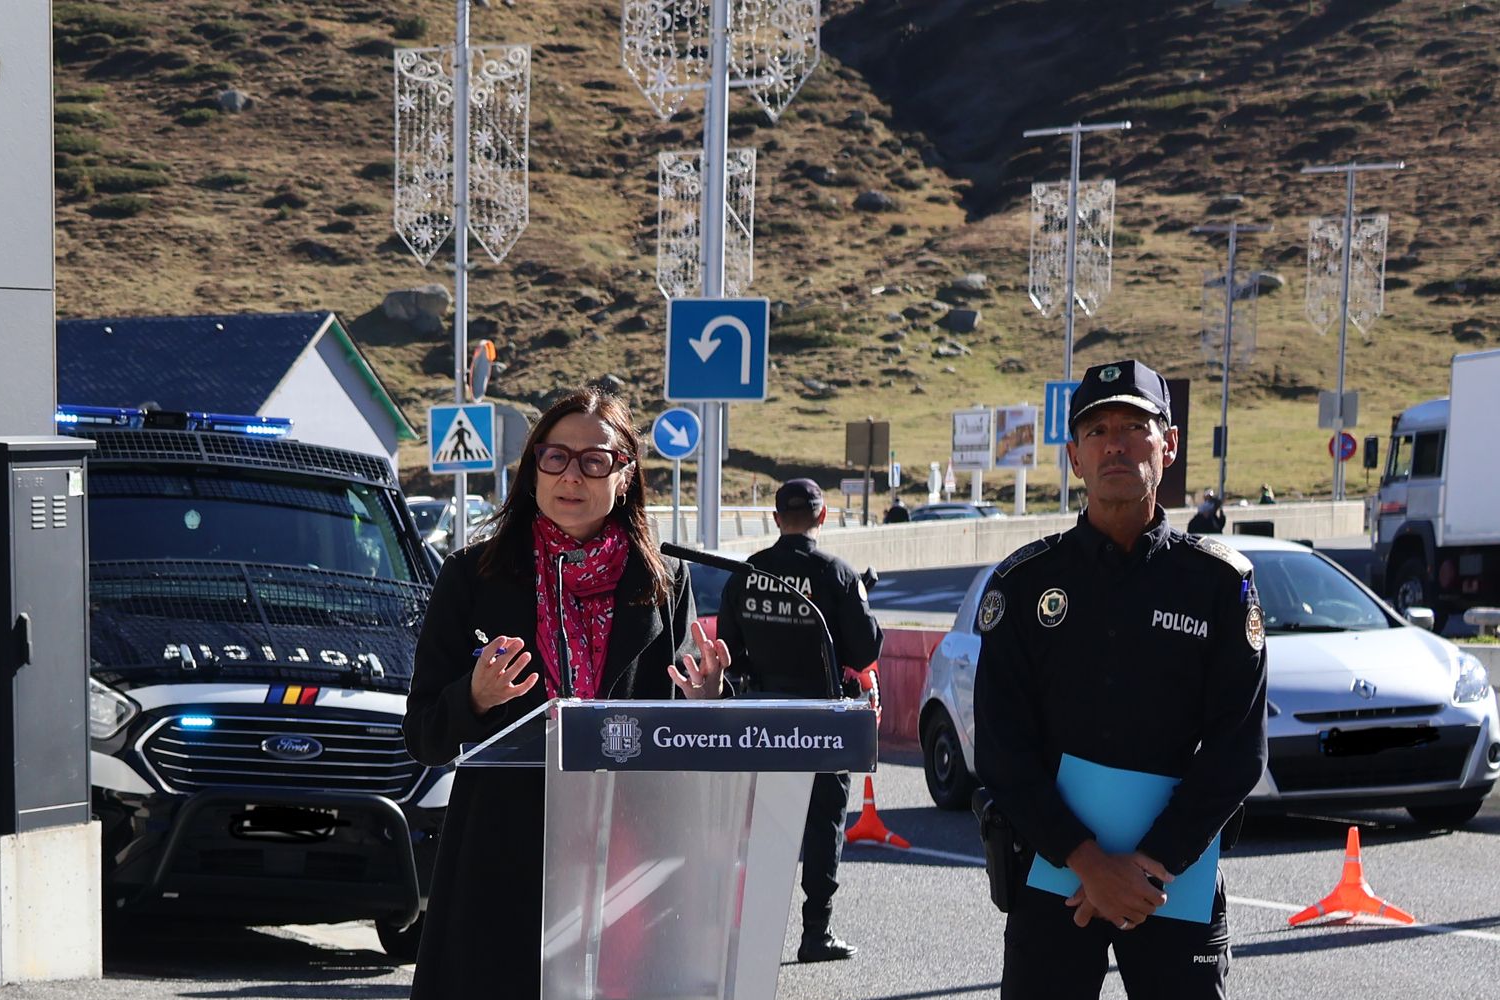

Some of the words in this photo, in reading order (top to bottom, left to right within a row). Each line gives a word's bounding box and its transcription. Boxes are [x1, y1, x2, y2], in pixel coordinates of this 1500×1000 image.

[745, 572, 812, 595] POLICIA
[1151, 609, 1209, 638] POLICIA
[276, 738, 311, 754] Ford
[652, 726, 733, 749] Govern
[738, 726, 845, 749] d'Andorra
